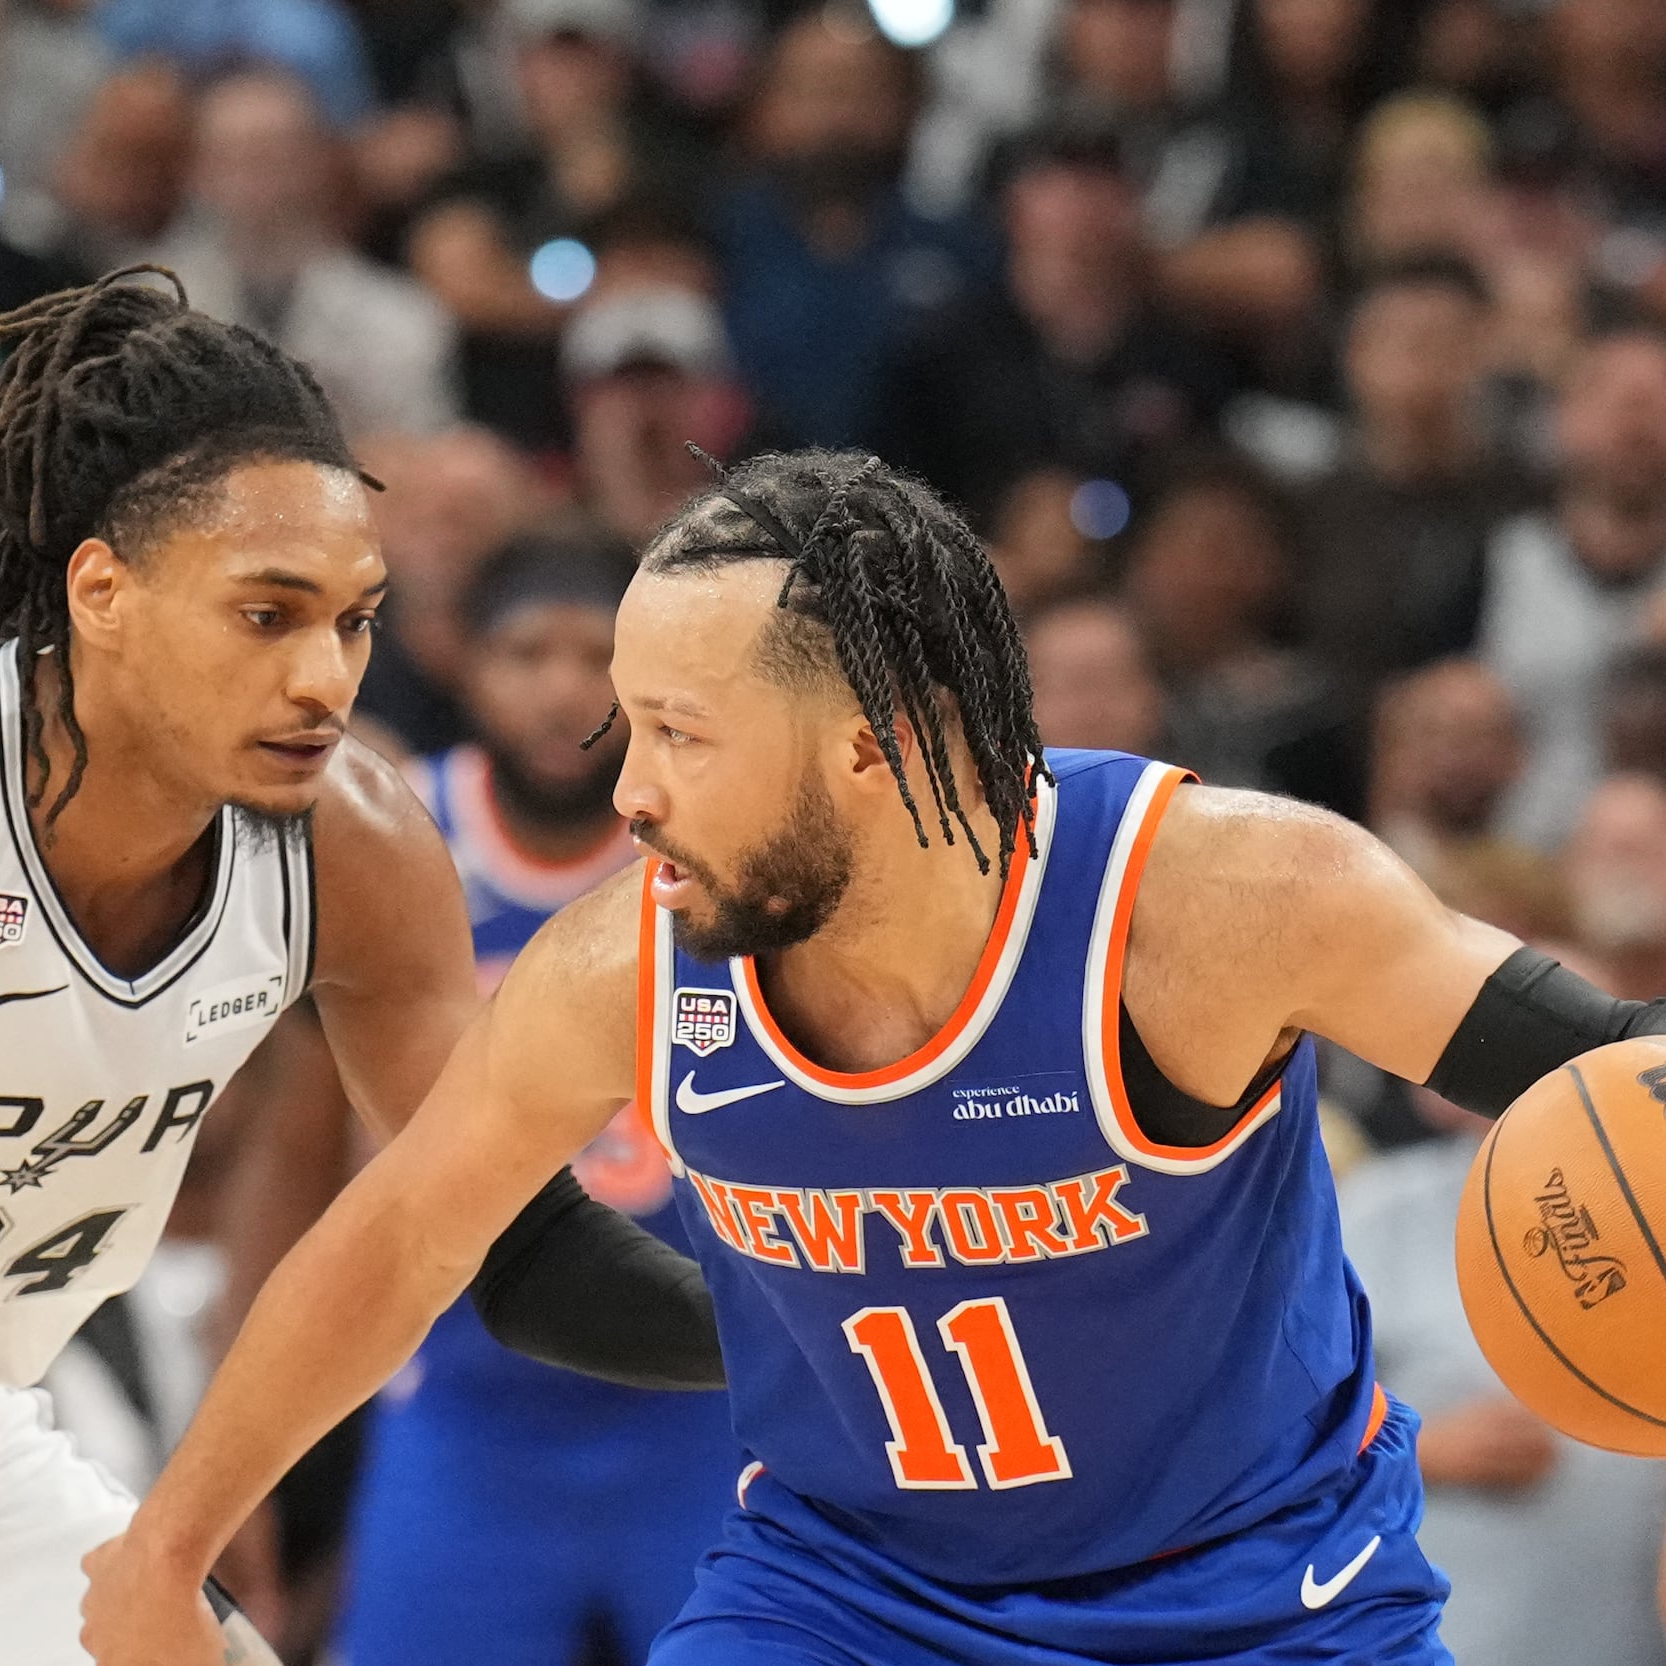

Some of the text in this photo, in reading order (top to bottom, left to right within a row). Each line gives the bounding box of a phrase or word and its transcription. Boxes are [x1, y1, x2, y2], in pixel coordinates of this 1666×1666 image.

[198, 991, 267, 1026] LEDGER
[680, 997, 728, 1014] USA
[676, 1022, 730, 1041] 250
[952, 1086, 1021, 1099] experience
[952, 1100, 1002, 1120] abu
[685, 1163, 1150, 1275] NEW YORK
[841, 1297, 1073, 1491] 11
